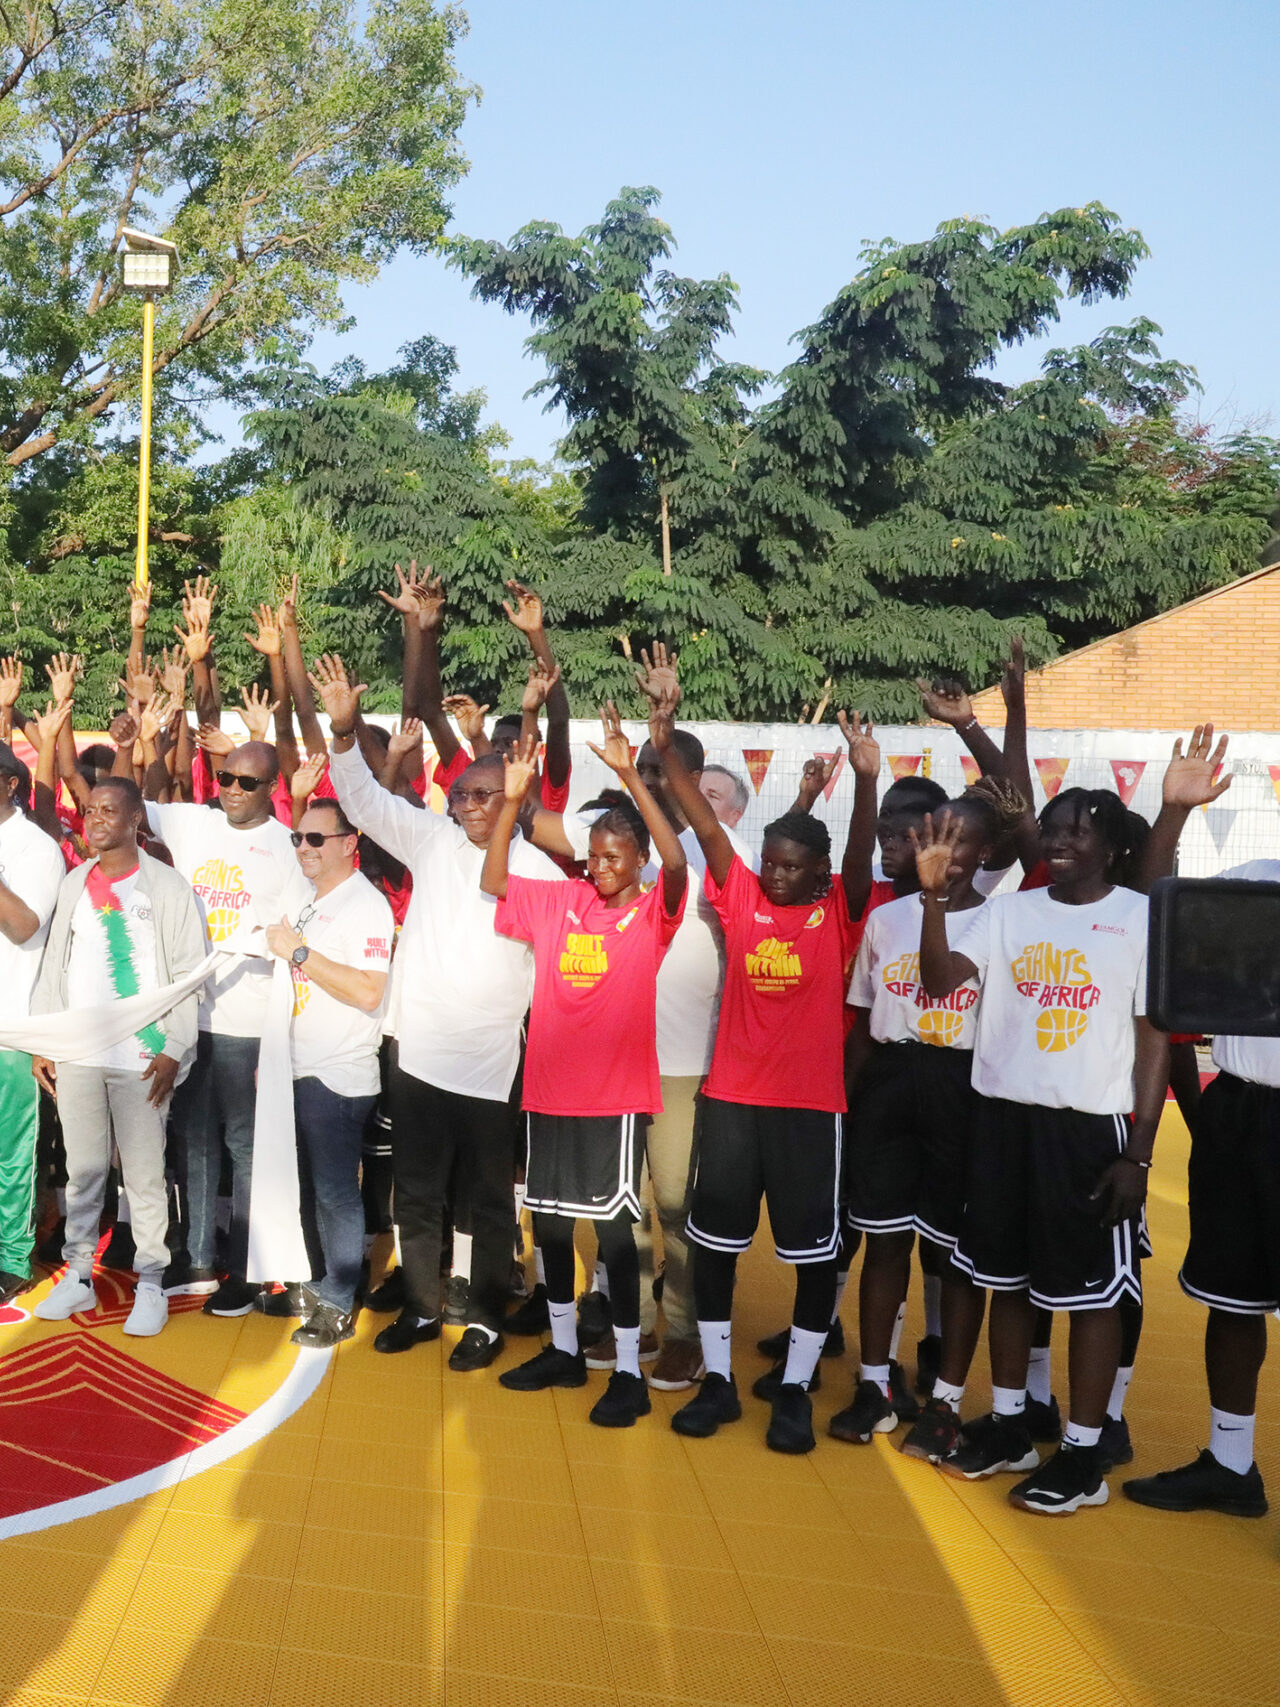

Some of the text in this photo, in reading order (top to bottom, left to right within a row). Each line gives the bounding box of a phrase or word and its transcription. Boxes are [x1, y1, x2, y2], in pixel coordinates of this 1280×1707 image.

[192, 884, 252, 910] OF AFRICA
[566, 933, 605, 956] BUILT
[745, 952, 802, 978] WITHIN
[885, 981, 916, 998] OF
[1016, 981, 1101, 1011] OF AFRICA
